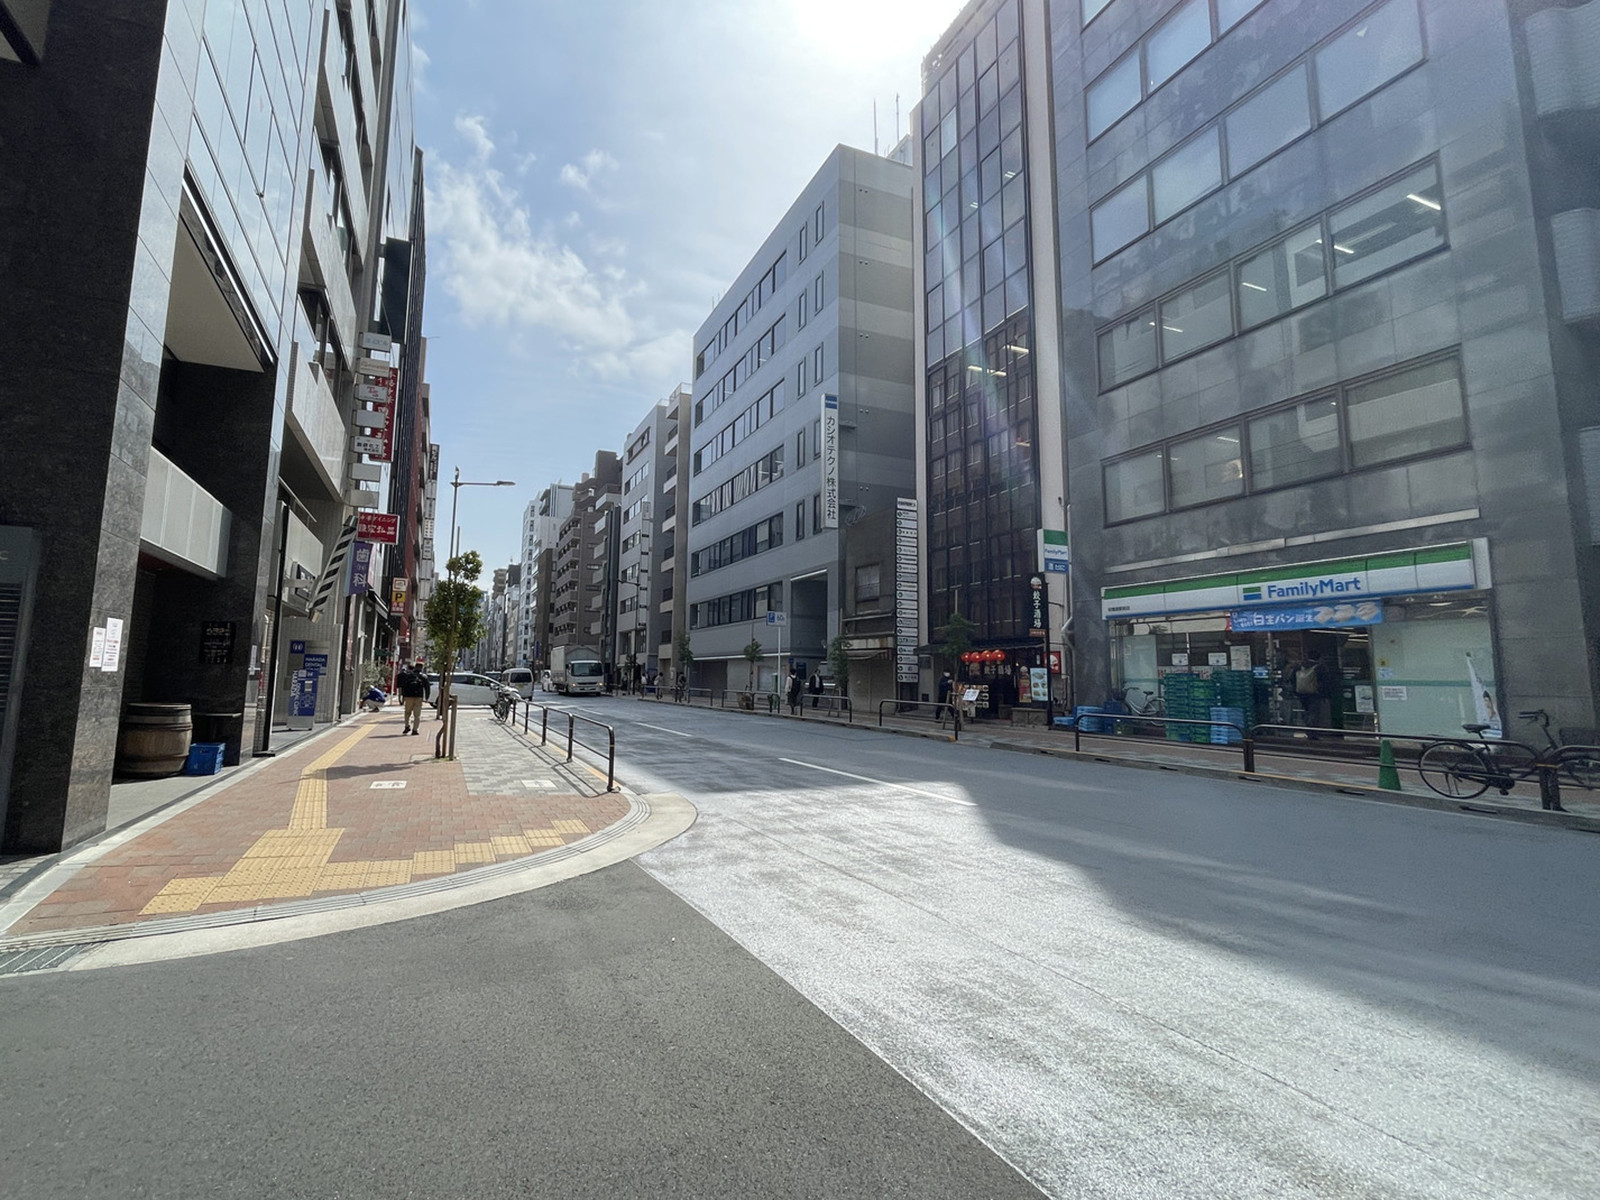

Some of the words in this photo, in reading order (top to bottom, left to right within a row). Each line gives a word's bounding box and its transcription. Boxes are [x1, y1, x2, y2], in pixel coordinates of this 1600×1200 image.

[827, 416, 836, 519] カシオテクノ株式会社
[352, 548, 370, 587] 歯科
[395, 592, 402, 601] P
[1267, 577, 1361, 599] FamilyMart
